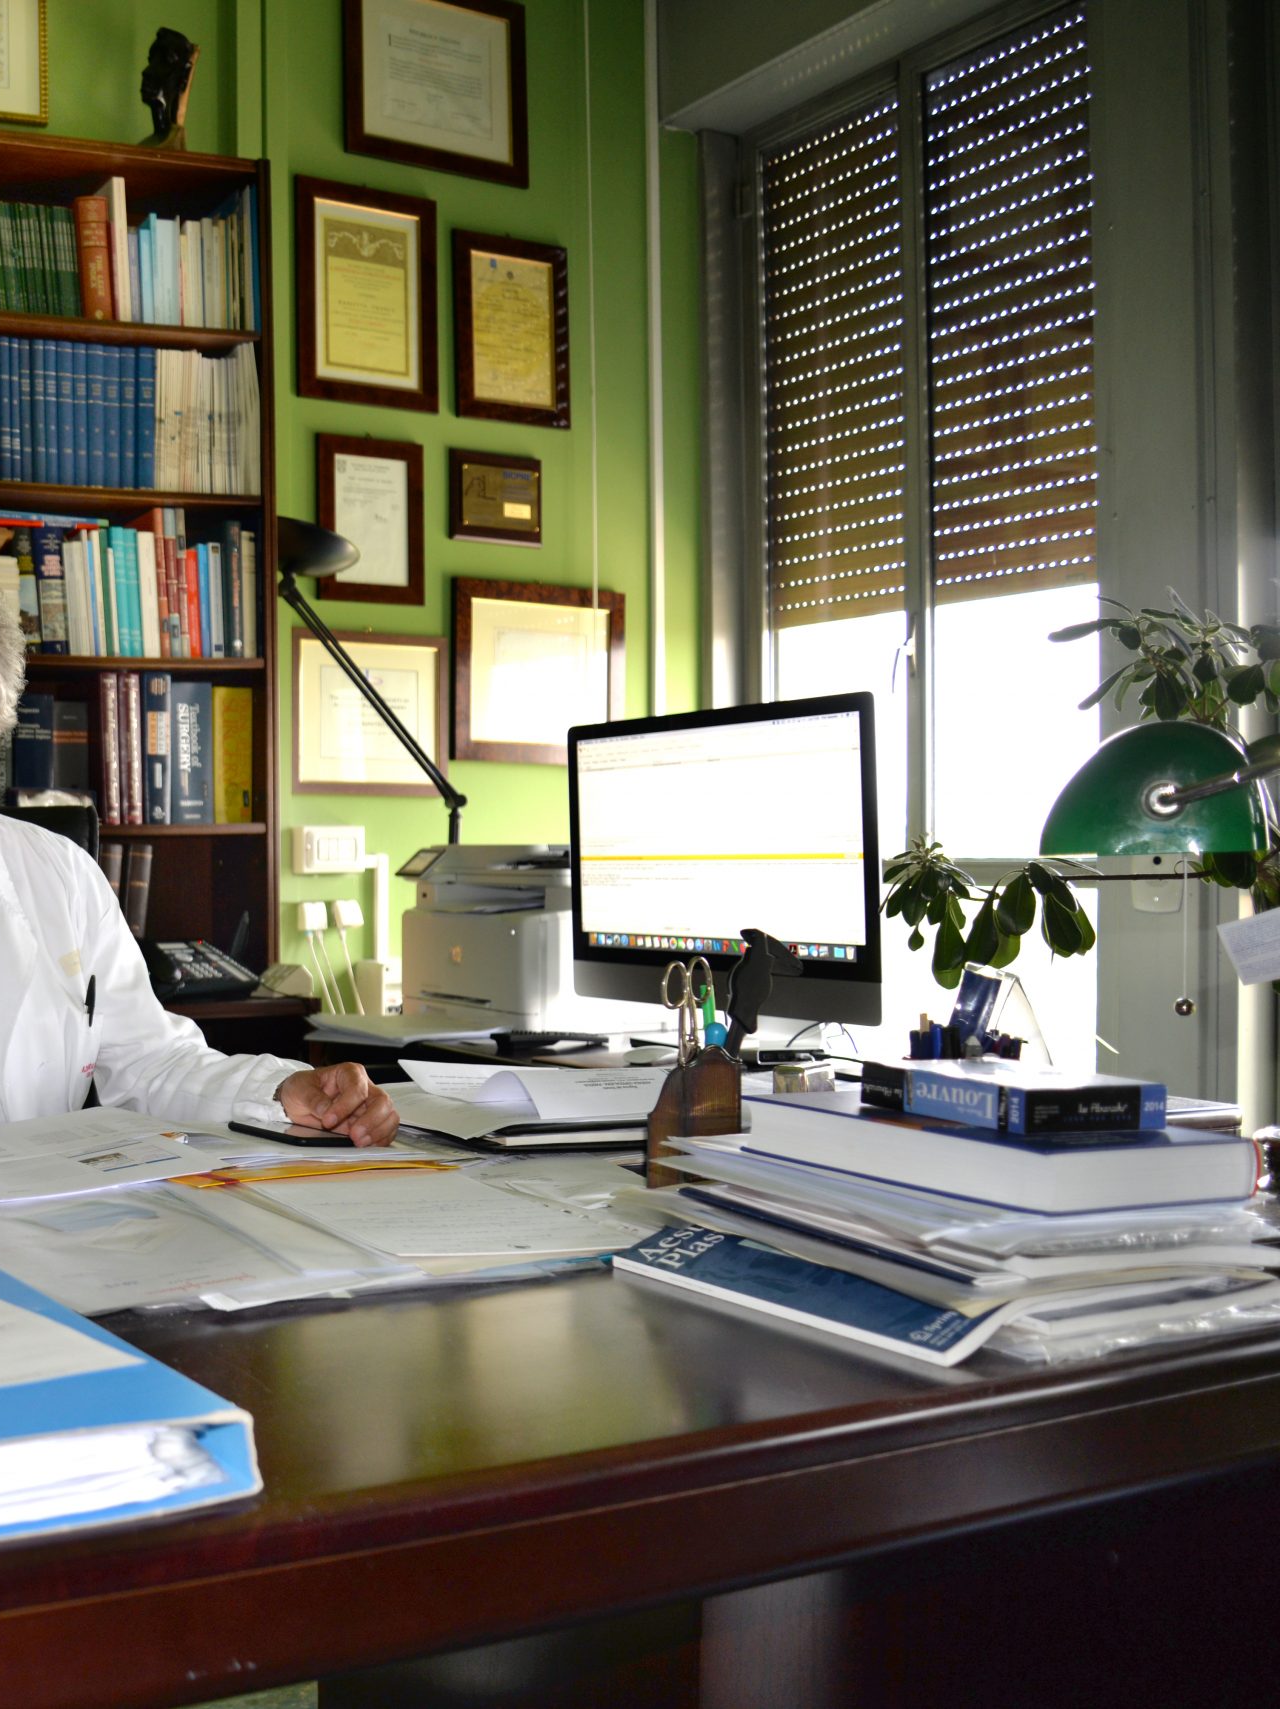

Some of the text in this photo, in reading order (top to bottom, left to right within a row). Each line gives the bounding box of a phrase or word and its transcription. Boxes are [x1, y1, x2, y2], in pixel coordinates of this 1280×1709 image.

[176, 703, 191, 773] SURGERY
[190, 703, 201, 754] Textbook
[916, 1081, 994, 1119] Louvre
[1010, 1096, 1020, 1124] 2014
[1144, 1101, 1165, 1112] 2014
[656, 1231, 725, 1270] Plas
